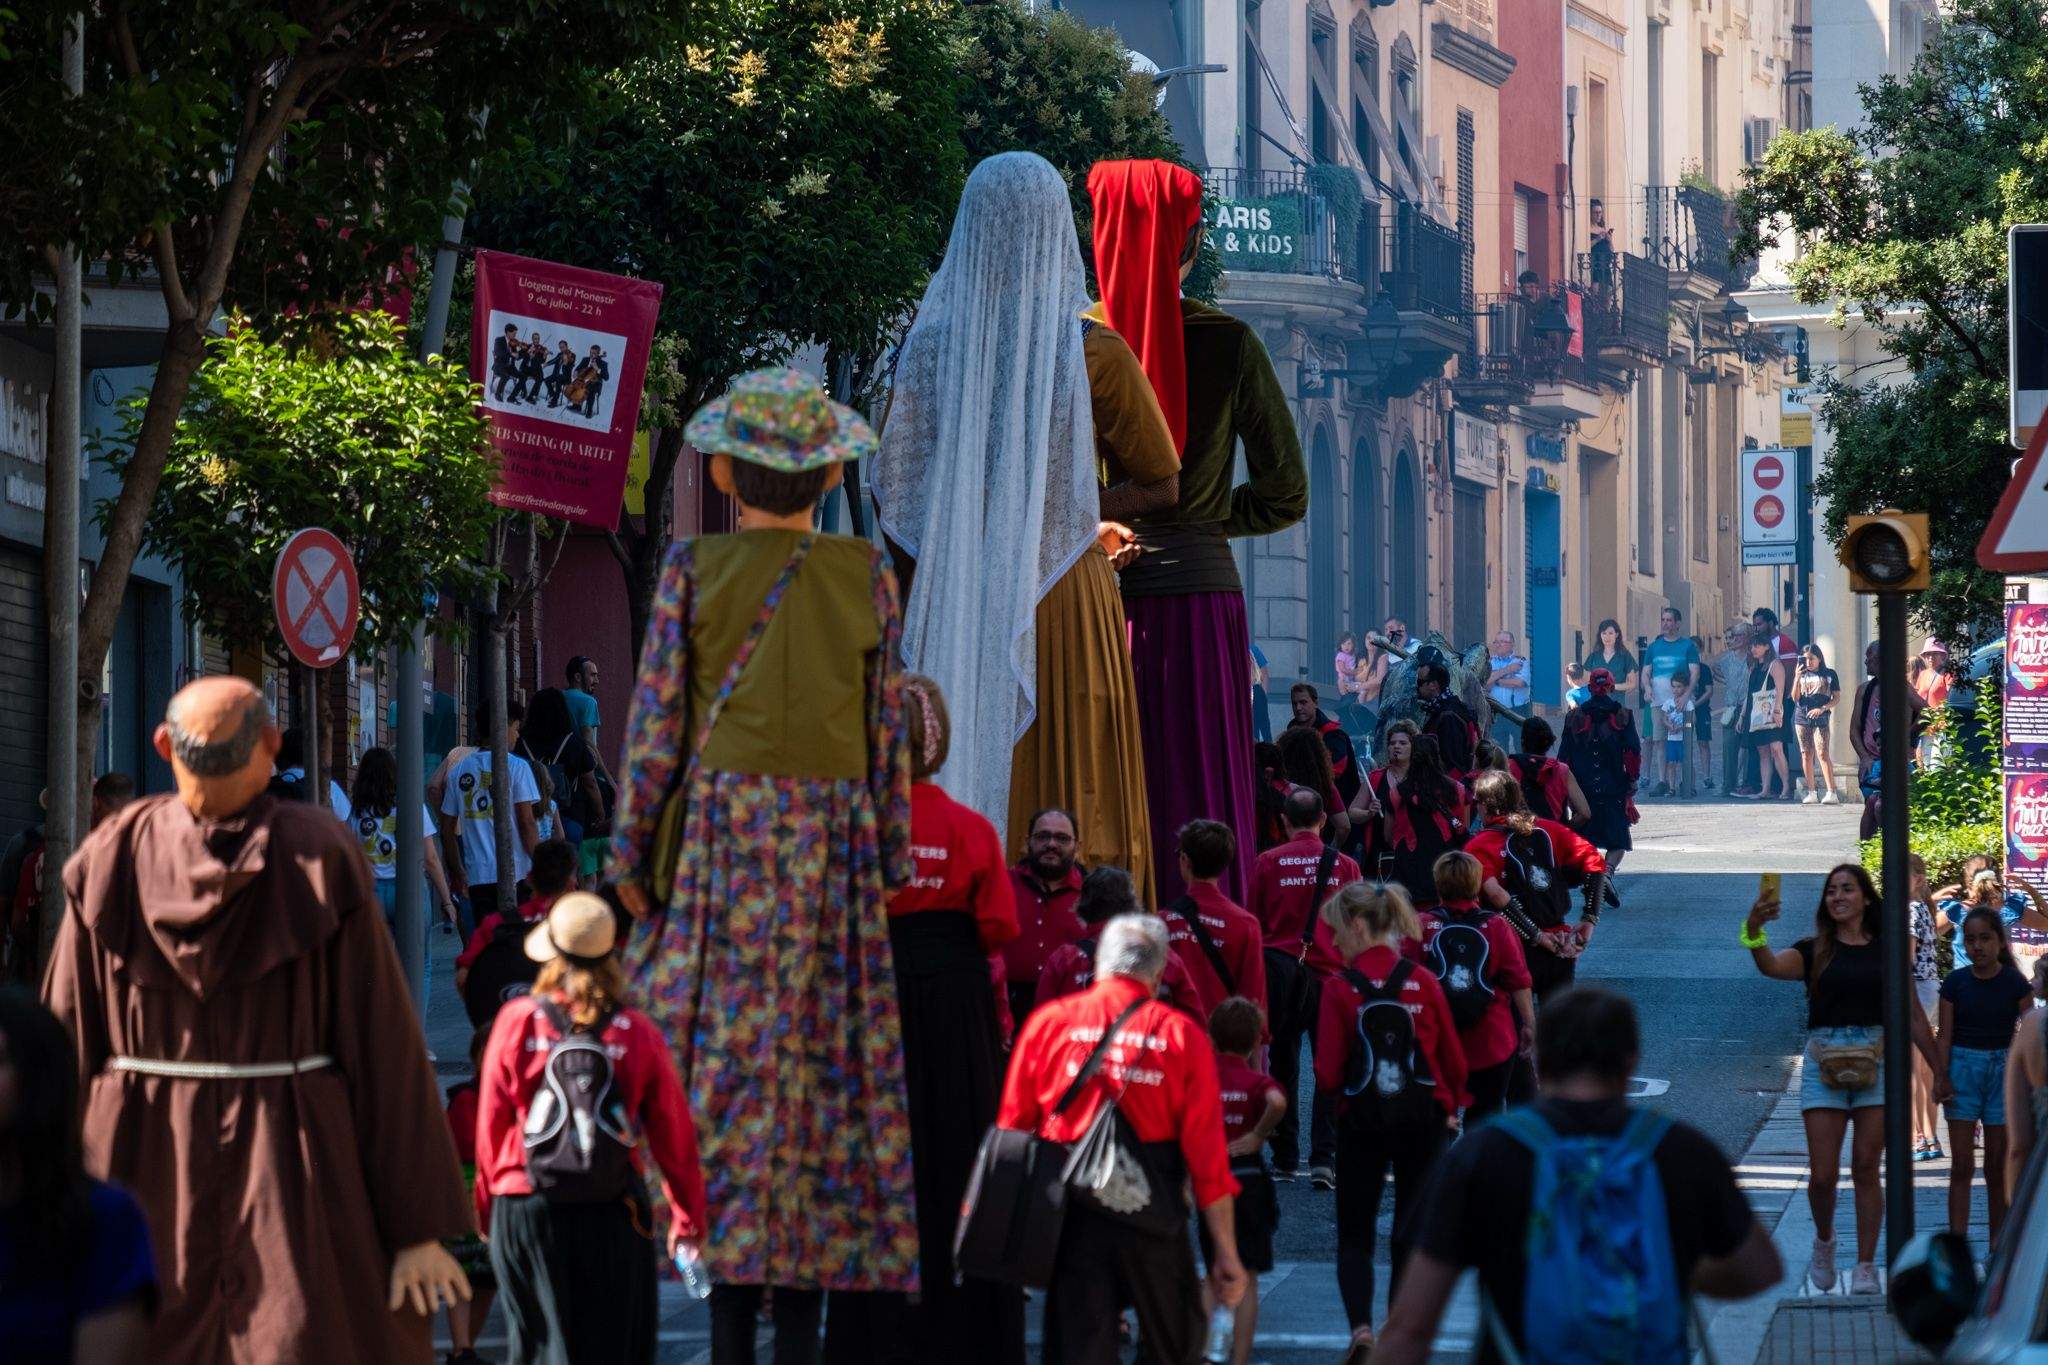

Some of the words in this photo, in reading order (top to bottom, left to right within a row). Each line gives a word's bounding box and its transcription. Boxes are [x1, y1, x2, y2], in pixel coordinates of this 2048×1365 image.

[1225, 232, 1240, 252] &
[1248, 234, 1293, 255] KIDS
[518, 277, 556, 294] Llotgeta
[558, 286, 573, 298] del
[574, 288, 616, 305] Monestir
[528, 293, 534, 302] 9
[536, 296, 548, 305] de
[549, 298, 573, 311] juliol
[582, 305, 593, 315] 22
[595, 306, 602, 316] h
[513, 430, 558, 450] STRING
[560, 438, 616, 462] QUARTET
[2019, 651, 2044, 667] 2022
[2020, 824, 2045, 837] 2022
[1279, 856, 1340, 867] GEGANTS
[1280, 878, 1307, 887] SANT
